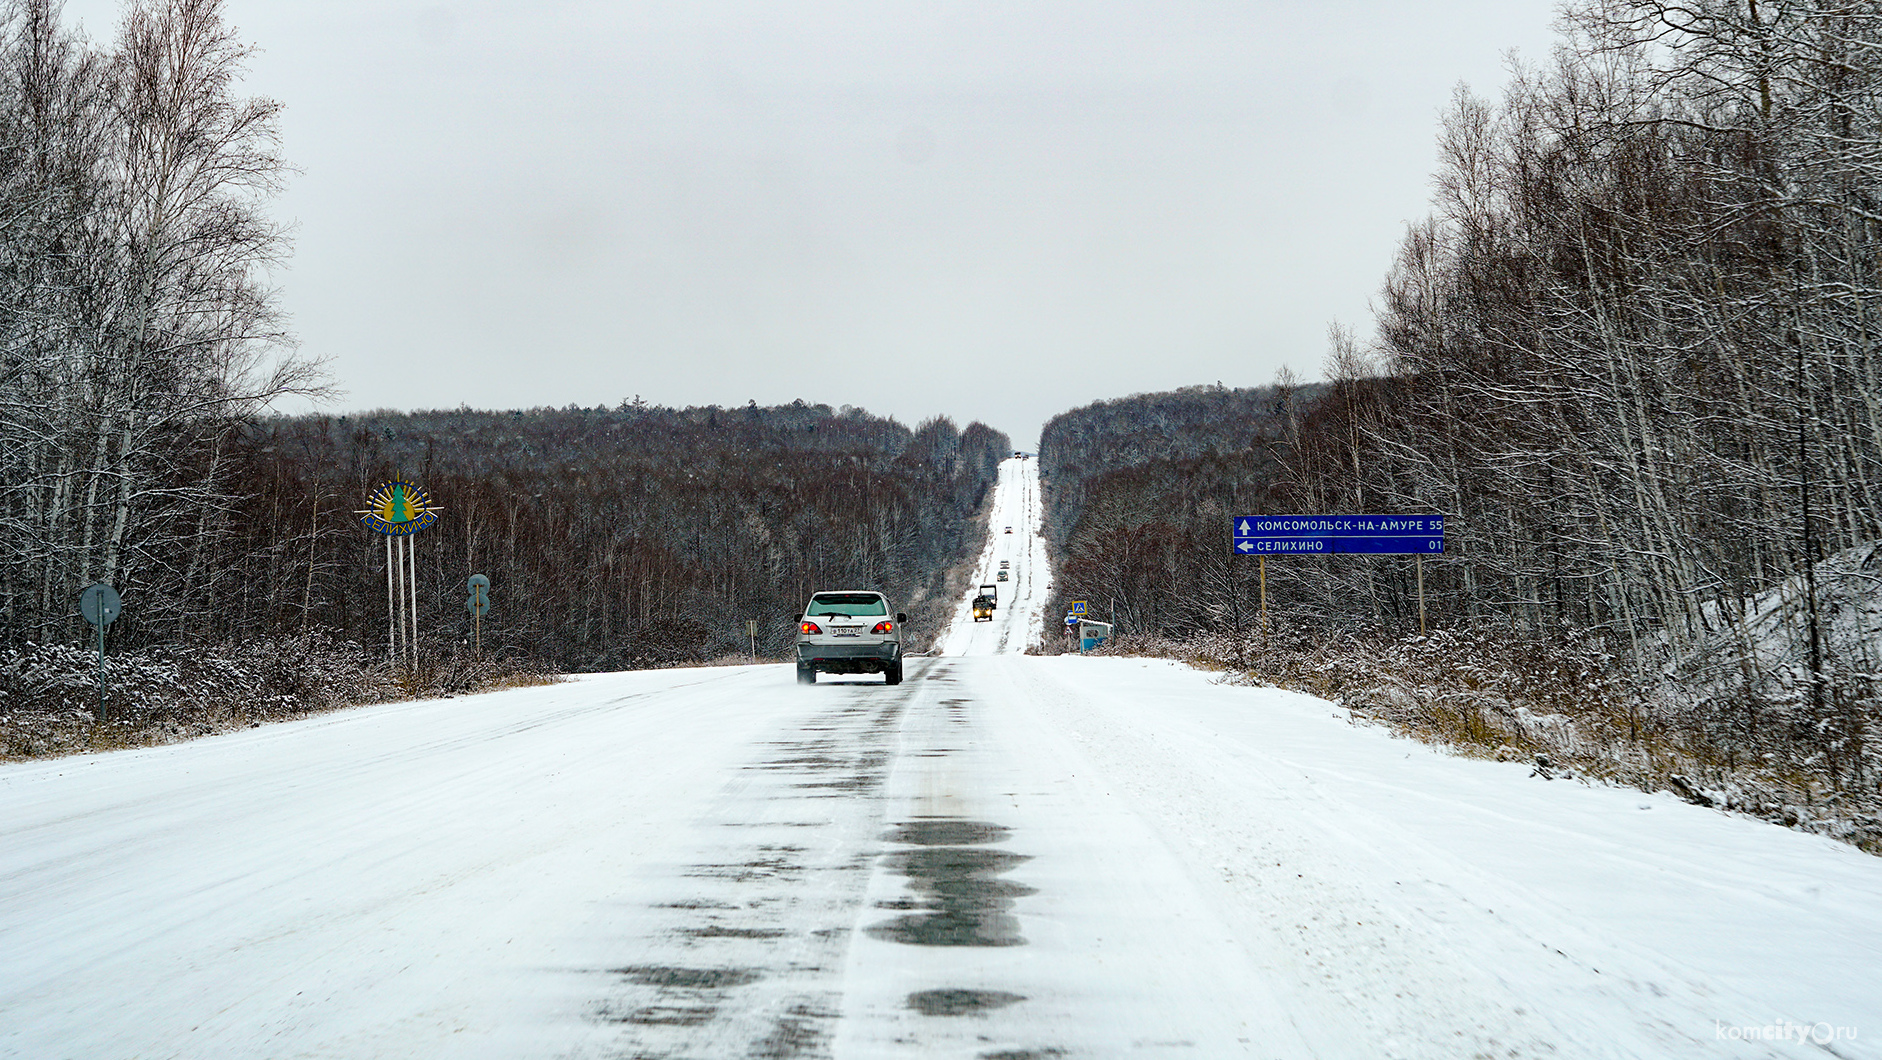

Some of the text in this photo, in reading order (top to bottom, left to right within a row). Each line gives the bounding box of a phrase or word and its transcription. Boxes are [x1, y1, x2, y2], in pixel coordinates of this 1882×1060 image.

[364, 513, 434, 534] СЕЛИХИНО
[1257, 520, 1443, 531] КОМСОМОЛЬСК-НА-АМУРЕ 55
[1256, 540, 1442, 551] СЕЛИХИНО 01
